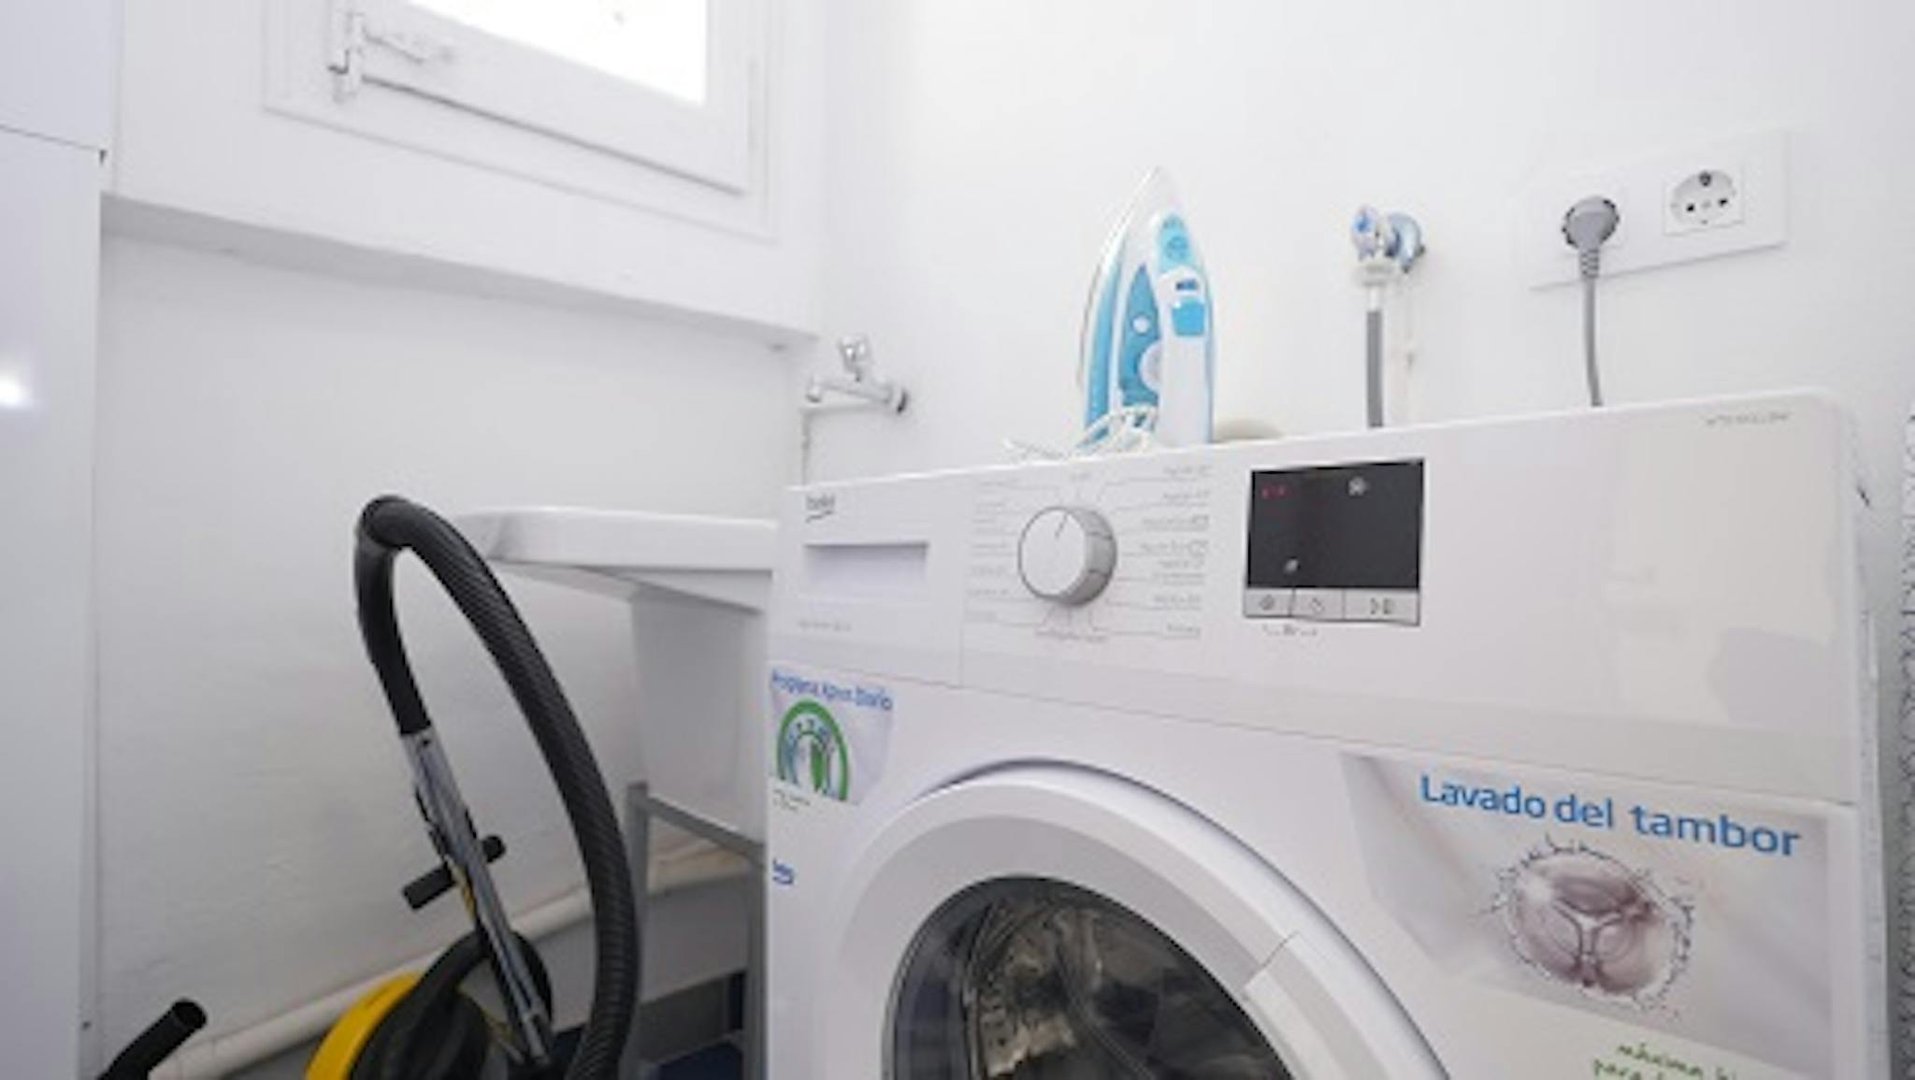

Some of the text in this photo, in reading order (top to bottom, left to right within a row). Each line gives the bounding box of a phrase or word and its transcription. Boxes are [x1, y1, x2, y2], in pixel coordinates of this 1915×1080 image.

[1420, 774, 1802, 856] Lavado del tambor
